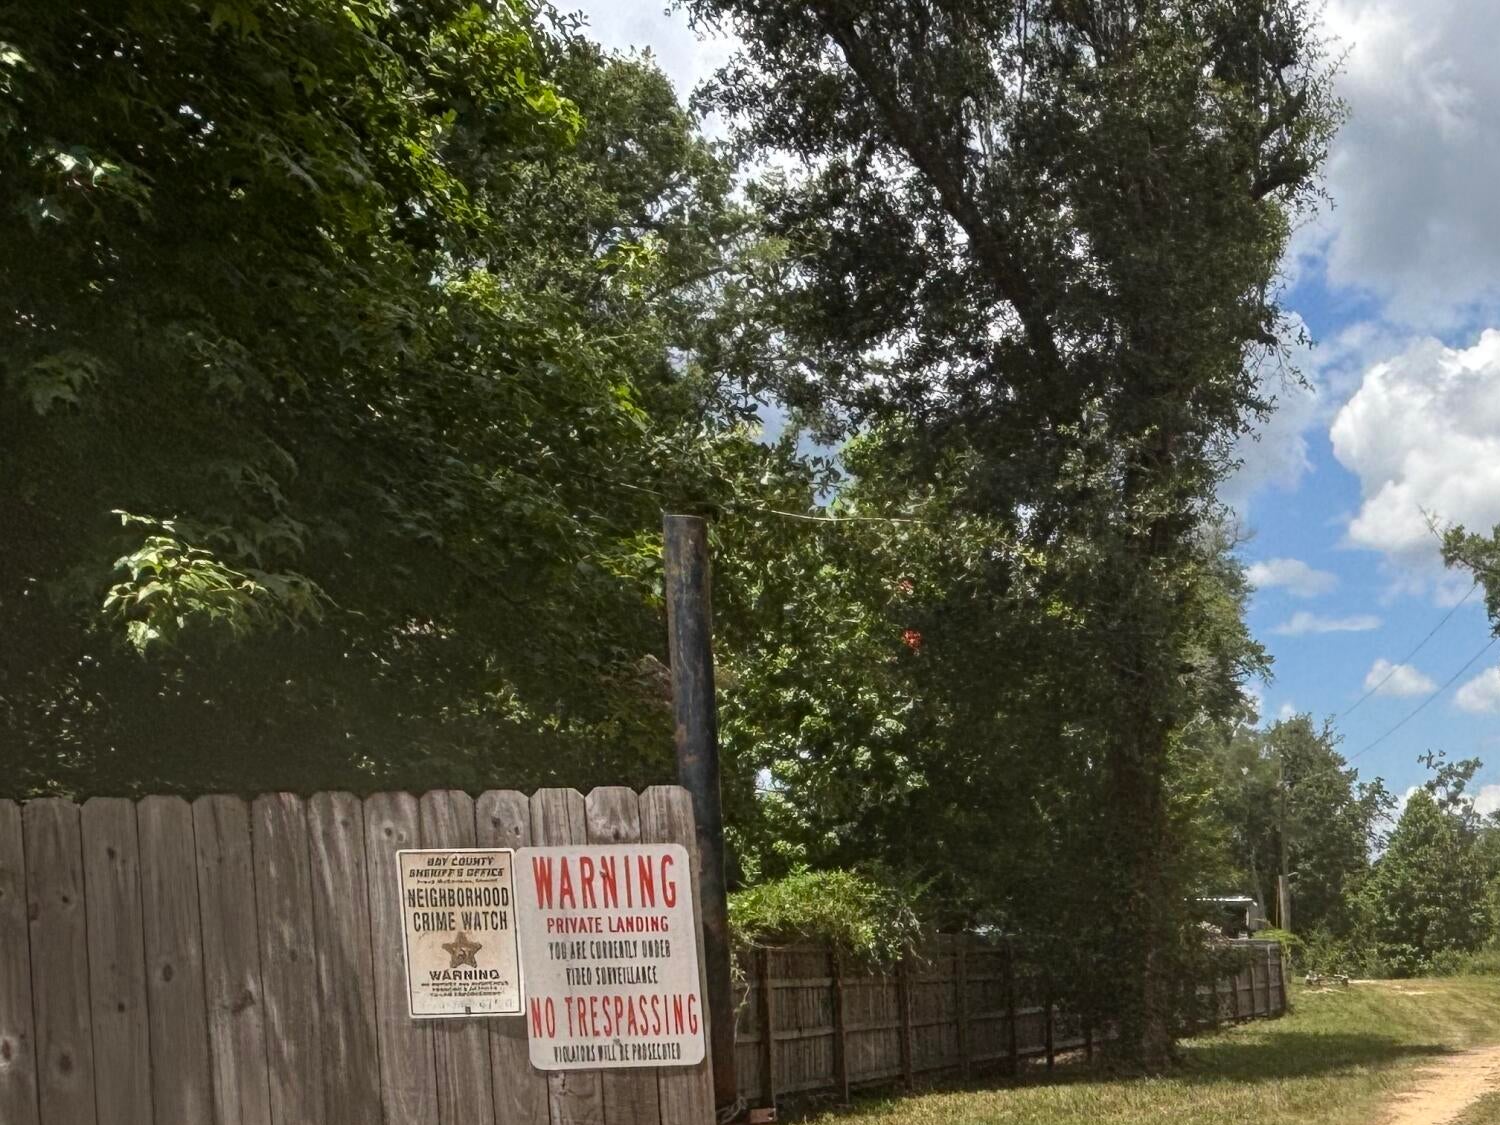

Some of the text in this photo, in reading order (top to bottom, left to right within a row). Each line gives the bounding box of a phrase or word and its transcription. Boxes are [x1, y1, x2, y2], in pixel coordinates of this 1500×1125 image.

[466, 867, 504, 877] OFFICE
[532, 854, 677, 910] WARNING
[407, 887, 509, 908] NEIGHBORHOOD
[414, 910, 508, 932] CRIME WATCH
[547, 915, 669, 934] PRIVATE LANDING
[549, 939, 671, 960] YOU ARE CURRENTLY UNDER
[429, 969, 500, 980] WARNING
[566, 965, 658, 986] VIDEO SURVEILLANCE
[530, 993, 698, 1038] NO TRESPASSING
[554, 1042, 681, 1063] VIOLATORS WILL BE PROSECUTED
